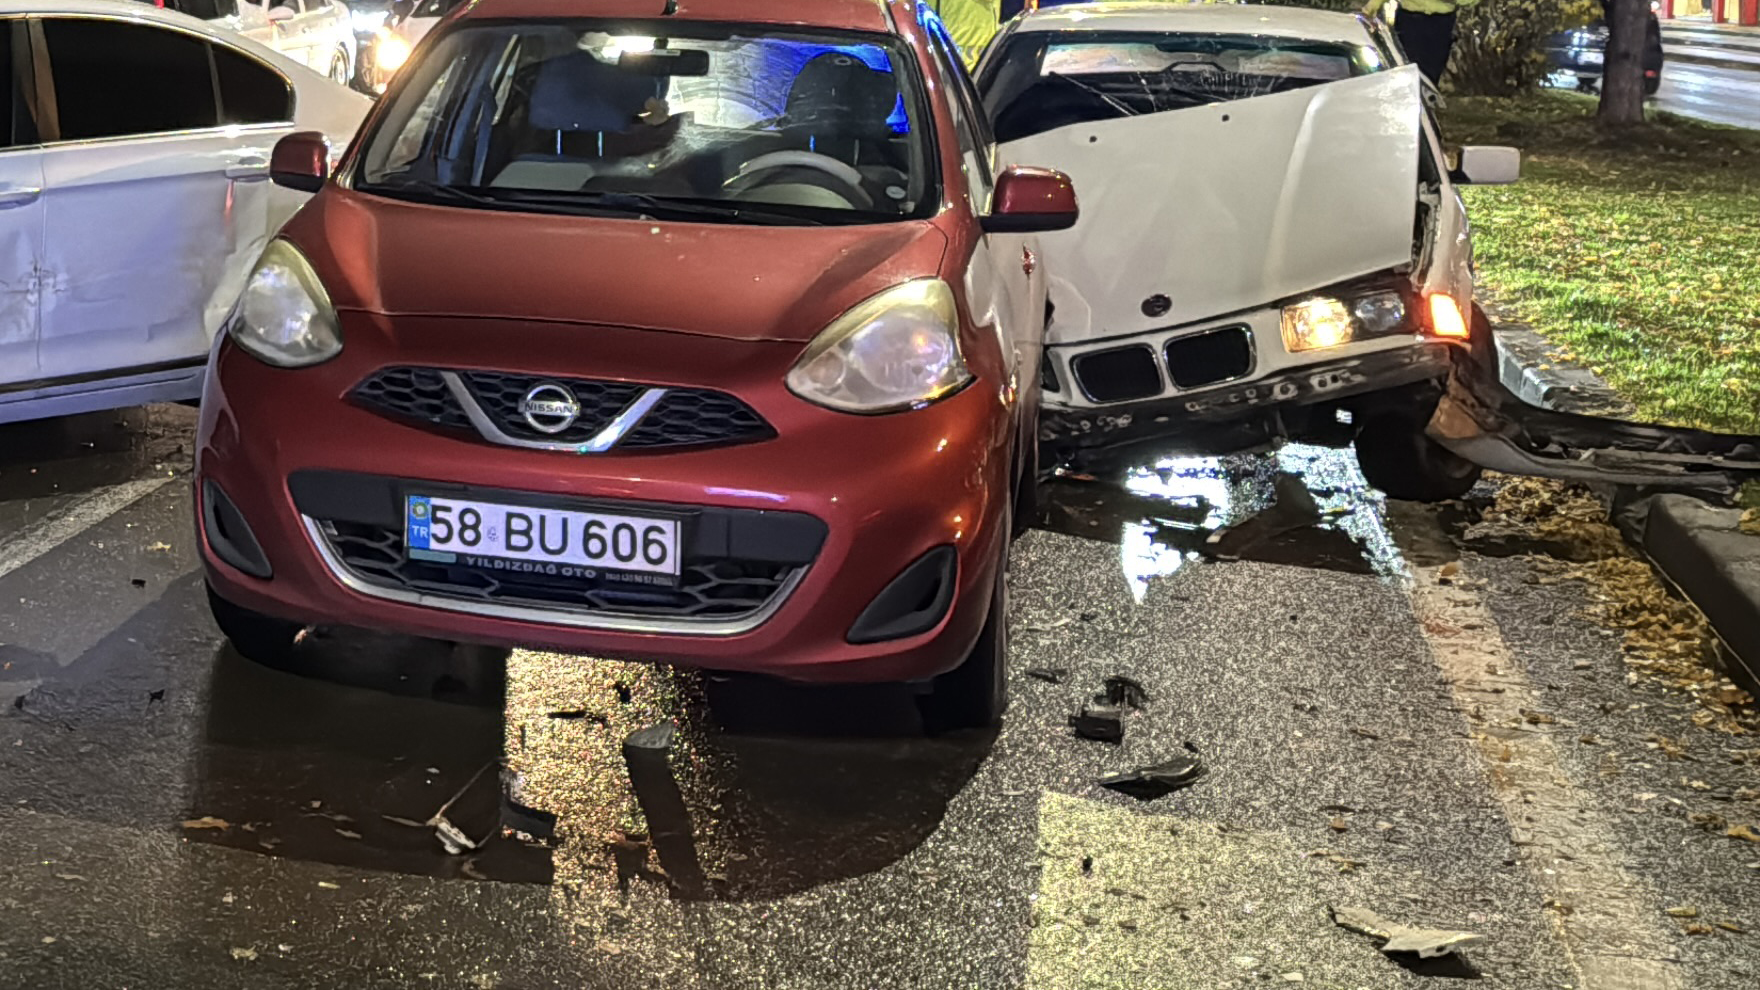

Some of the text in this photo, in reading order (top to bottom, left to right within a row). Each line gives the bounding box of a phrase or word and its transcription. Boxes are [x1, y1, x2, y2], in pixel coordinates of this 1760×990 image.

[524, 401, 573, 413] NISSAN
[411, 525, 428, 539] TR
[430, 504, 668, 566] 58 BU 606
[561, 566, 597, 579] OTO
